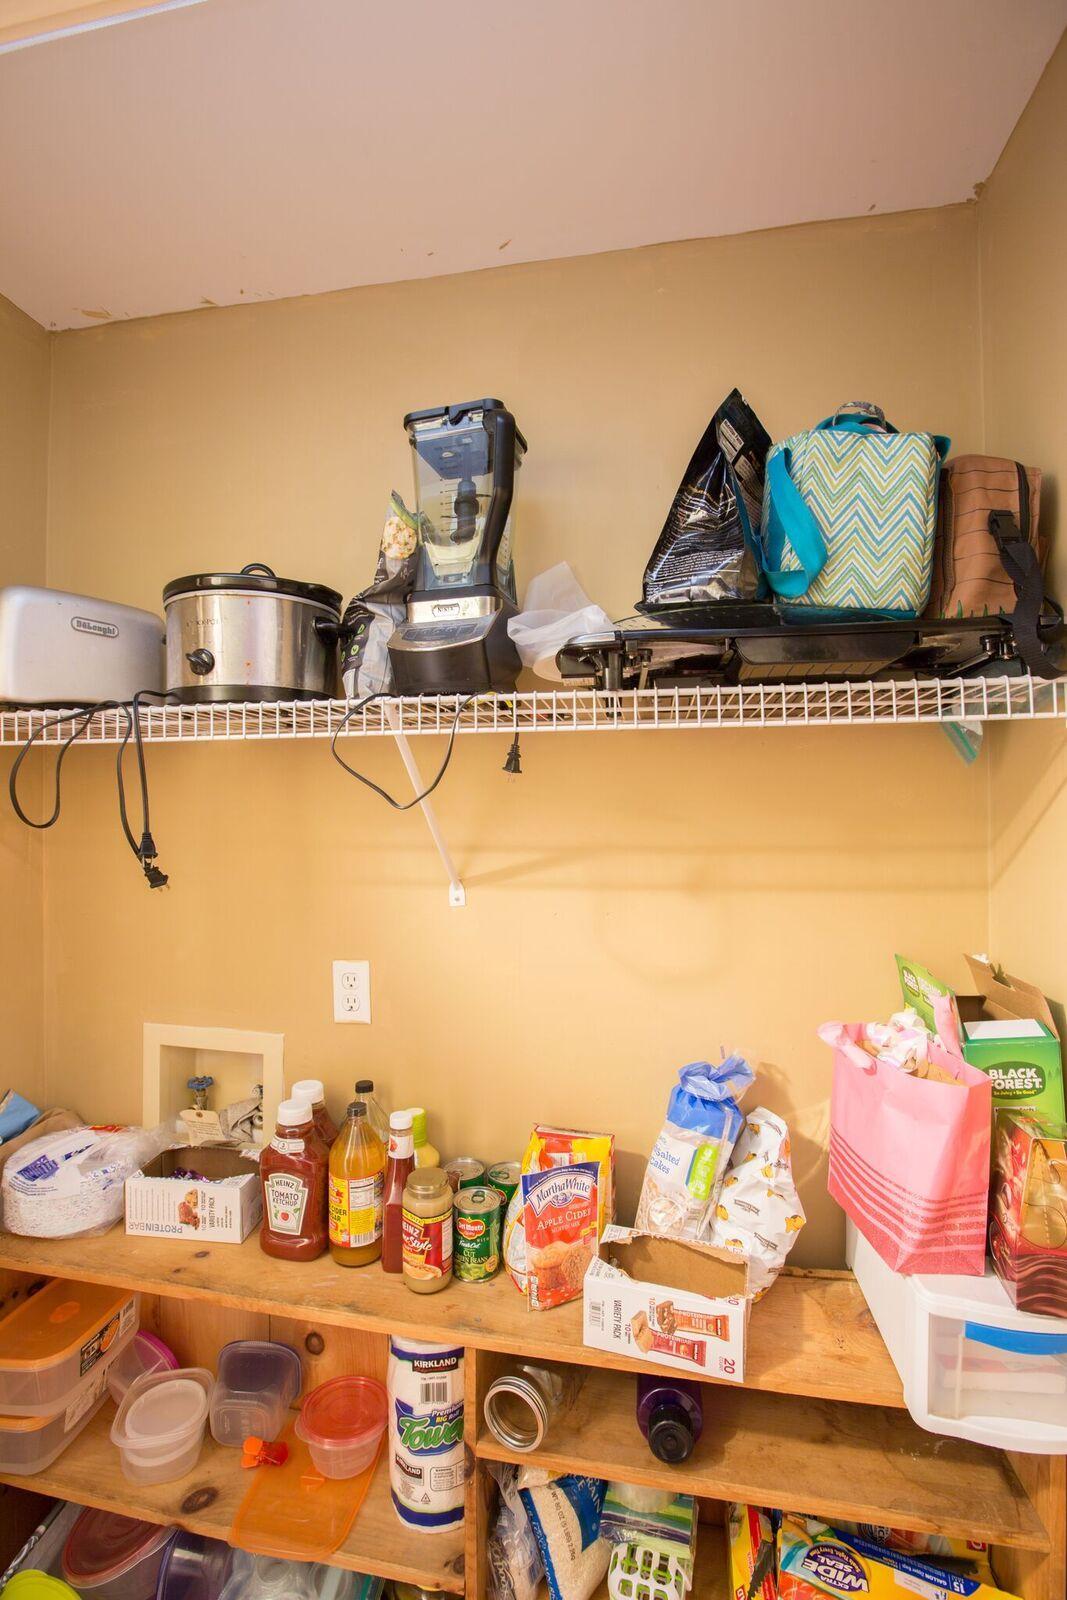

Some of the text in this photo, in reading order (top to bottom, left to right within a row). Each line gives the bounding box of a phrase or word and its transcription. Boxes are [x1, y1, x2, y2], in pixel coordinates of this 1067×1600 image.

[988, 1067, 1038, 1080] BLACK
[274, 1179, 295, 1190] HEINZ
[271, 1189, 299, 1201] TOMATO
[272, 1198, 298, 1207] KETCHUP
[401, 1220, 421, 1238] EINZ
[536, 1215, 564, 1231] APPLE
[463, 1249, 476, 1259] CUT
[612, 1300, 623, 1341] VARIETY PACK
[413, 1356, 457, 1369] KIRKLAND
[722, 1357, 735, 1375] 20
[435, 1414, 448, 1423] BIG
[817, 1554, 853, 1573] SEAL
[801, 1558, 869, 1593] WIDE
[924, 1572, 948, 1586] GALLON
[820, 1575, 850, 1590] EXTRA
[952, 1581, 966, 1594] 15
